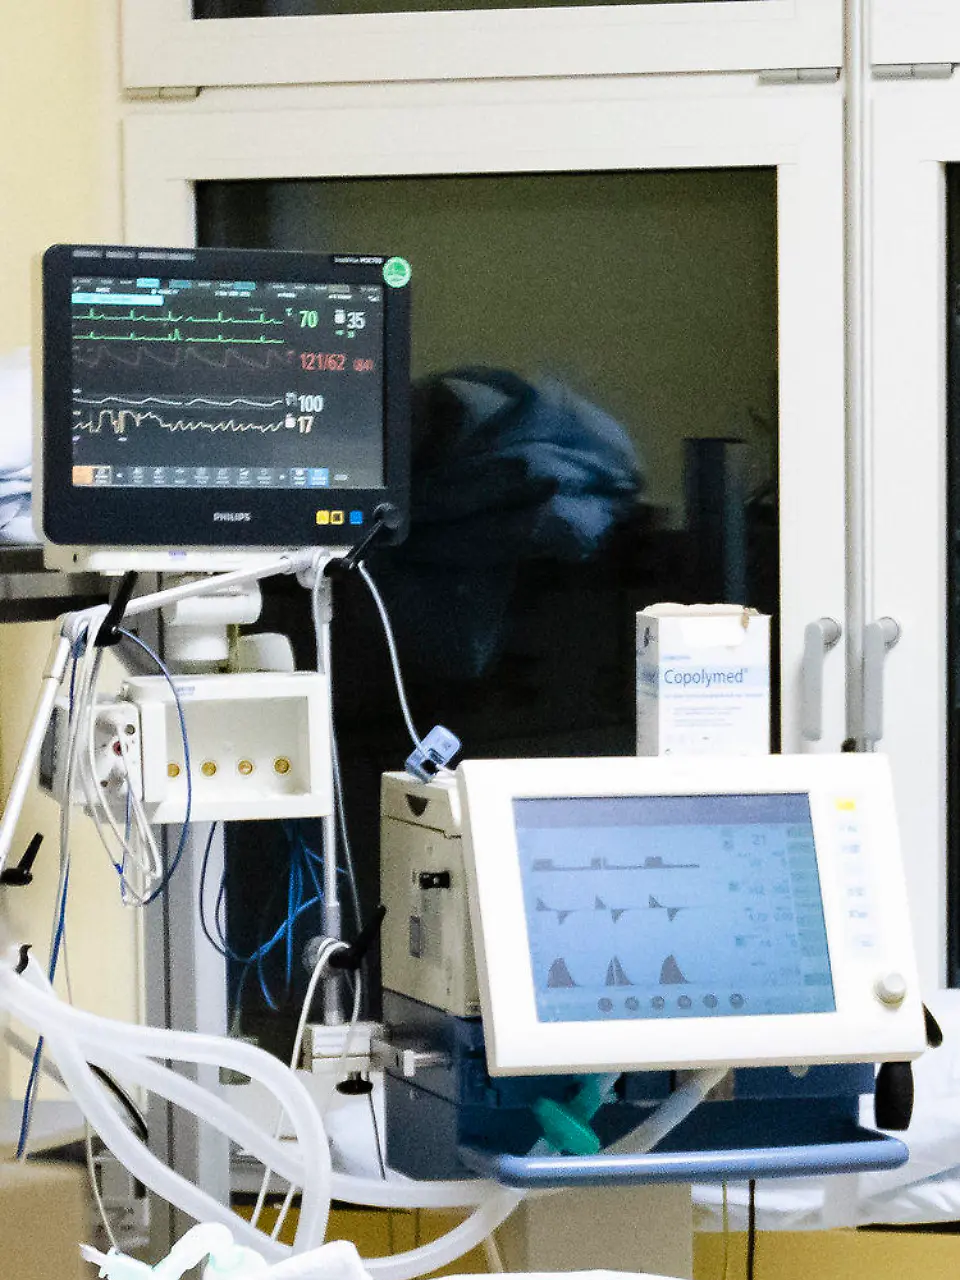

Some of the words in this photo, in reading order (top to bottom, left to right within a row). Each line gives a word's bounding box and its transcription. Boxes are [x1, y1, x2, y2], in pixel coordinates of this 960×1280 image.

[299, 310, 319, 329] 70
[346, 311, 366, 330] 35
[300, 352, 345, 371] 121/62
[298, 394, 324, 413] 100
[298, 415, 314, 433] 17
[213, 512, 251, 522] PHILIPS
[663, 668, 745, 688] Copolymed
